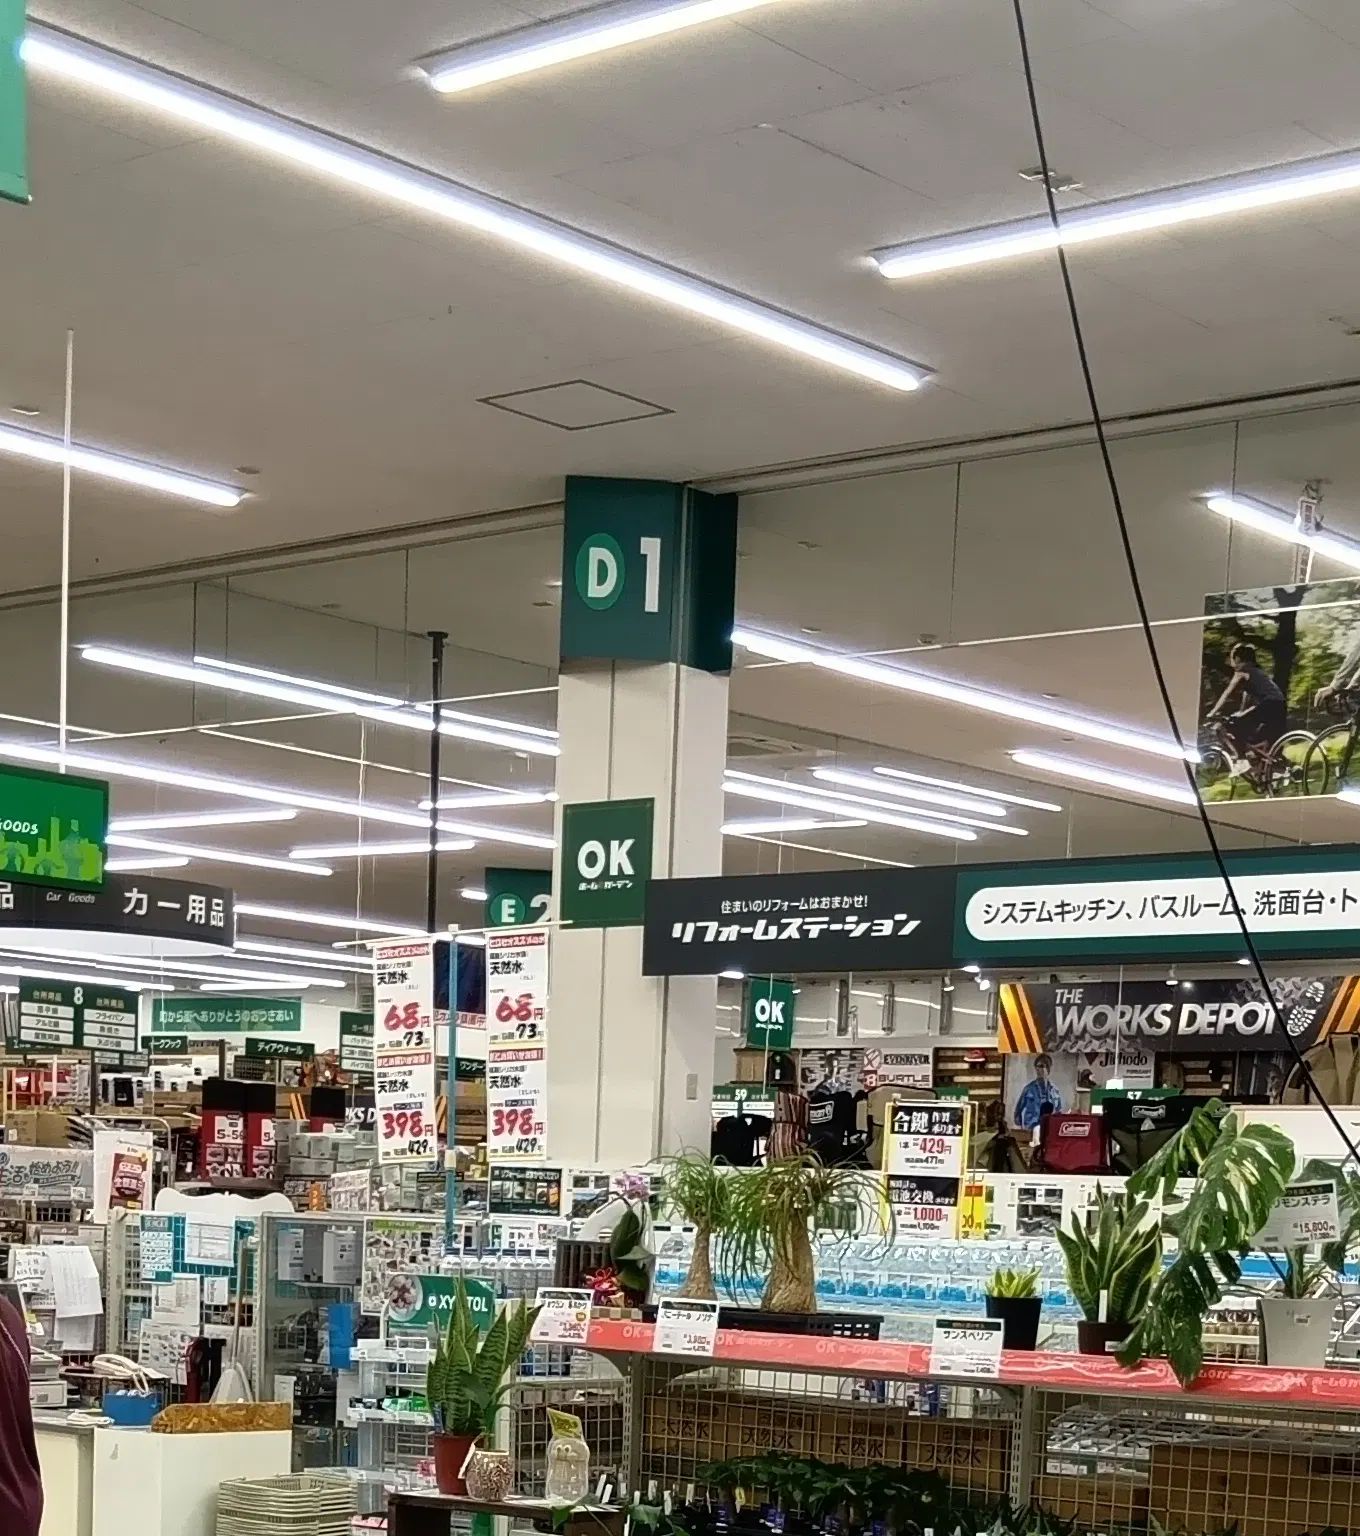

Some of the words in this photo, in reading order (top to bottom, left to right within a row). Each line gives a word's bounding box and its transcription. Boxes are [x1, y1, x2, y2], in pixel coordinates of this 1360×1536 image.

[583, 545, 618, 599] D
[640, 537, 662, 612] 1
[577, 838, 635, 879] OK
[46, 891, 63, 903] Car
[68, 892, 96, 905] Goods
[123, 887, 226, 929] カー用品
[721, 894, 869, 915] 住まいのリフォームはおまかせ!
[670, 914, 923, 944] リフォームステーション
[377, 971, 409, 986] 天然水
[490, 960, 524, 976] 天然水
[73, 986, 84, 1005] 8
[1055, 988, 1084, 1004] THE
[754, 998, 786, 1024] OK
[1054, 1003, 1174, 1038] WORKS
[1178, 1000, 1285, 1036] DEPOT
[377, 1078, 409, 1095] 天然水
